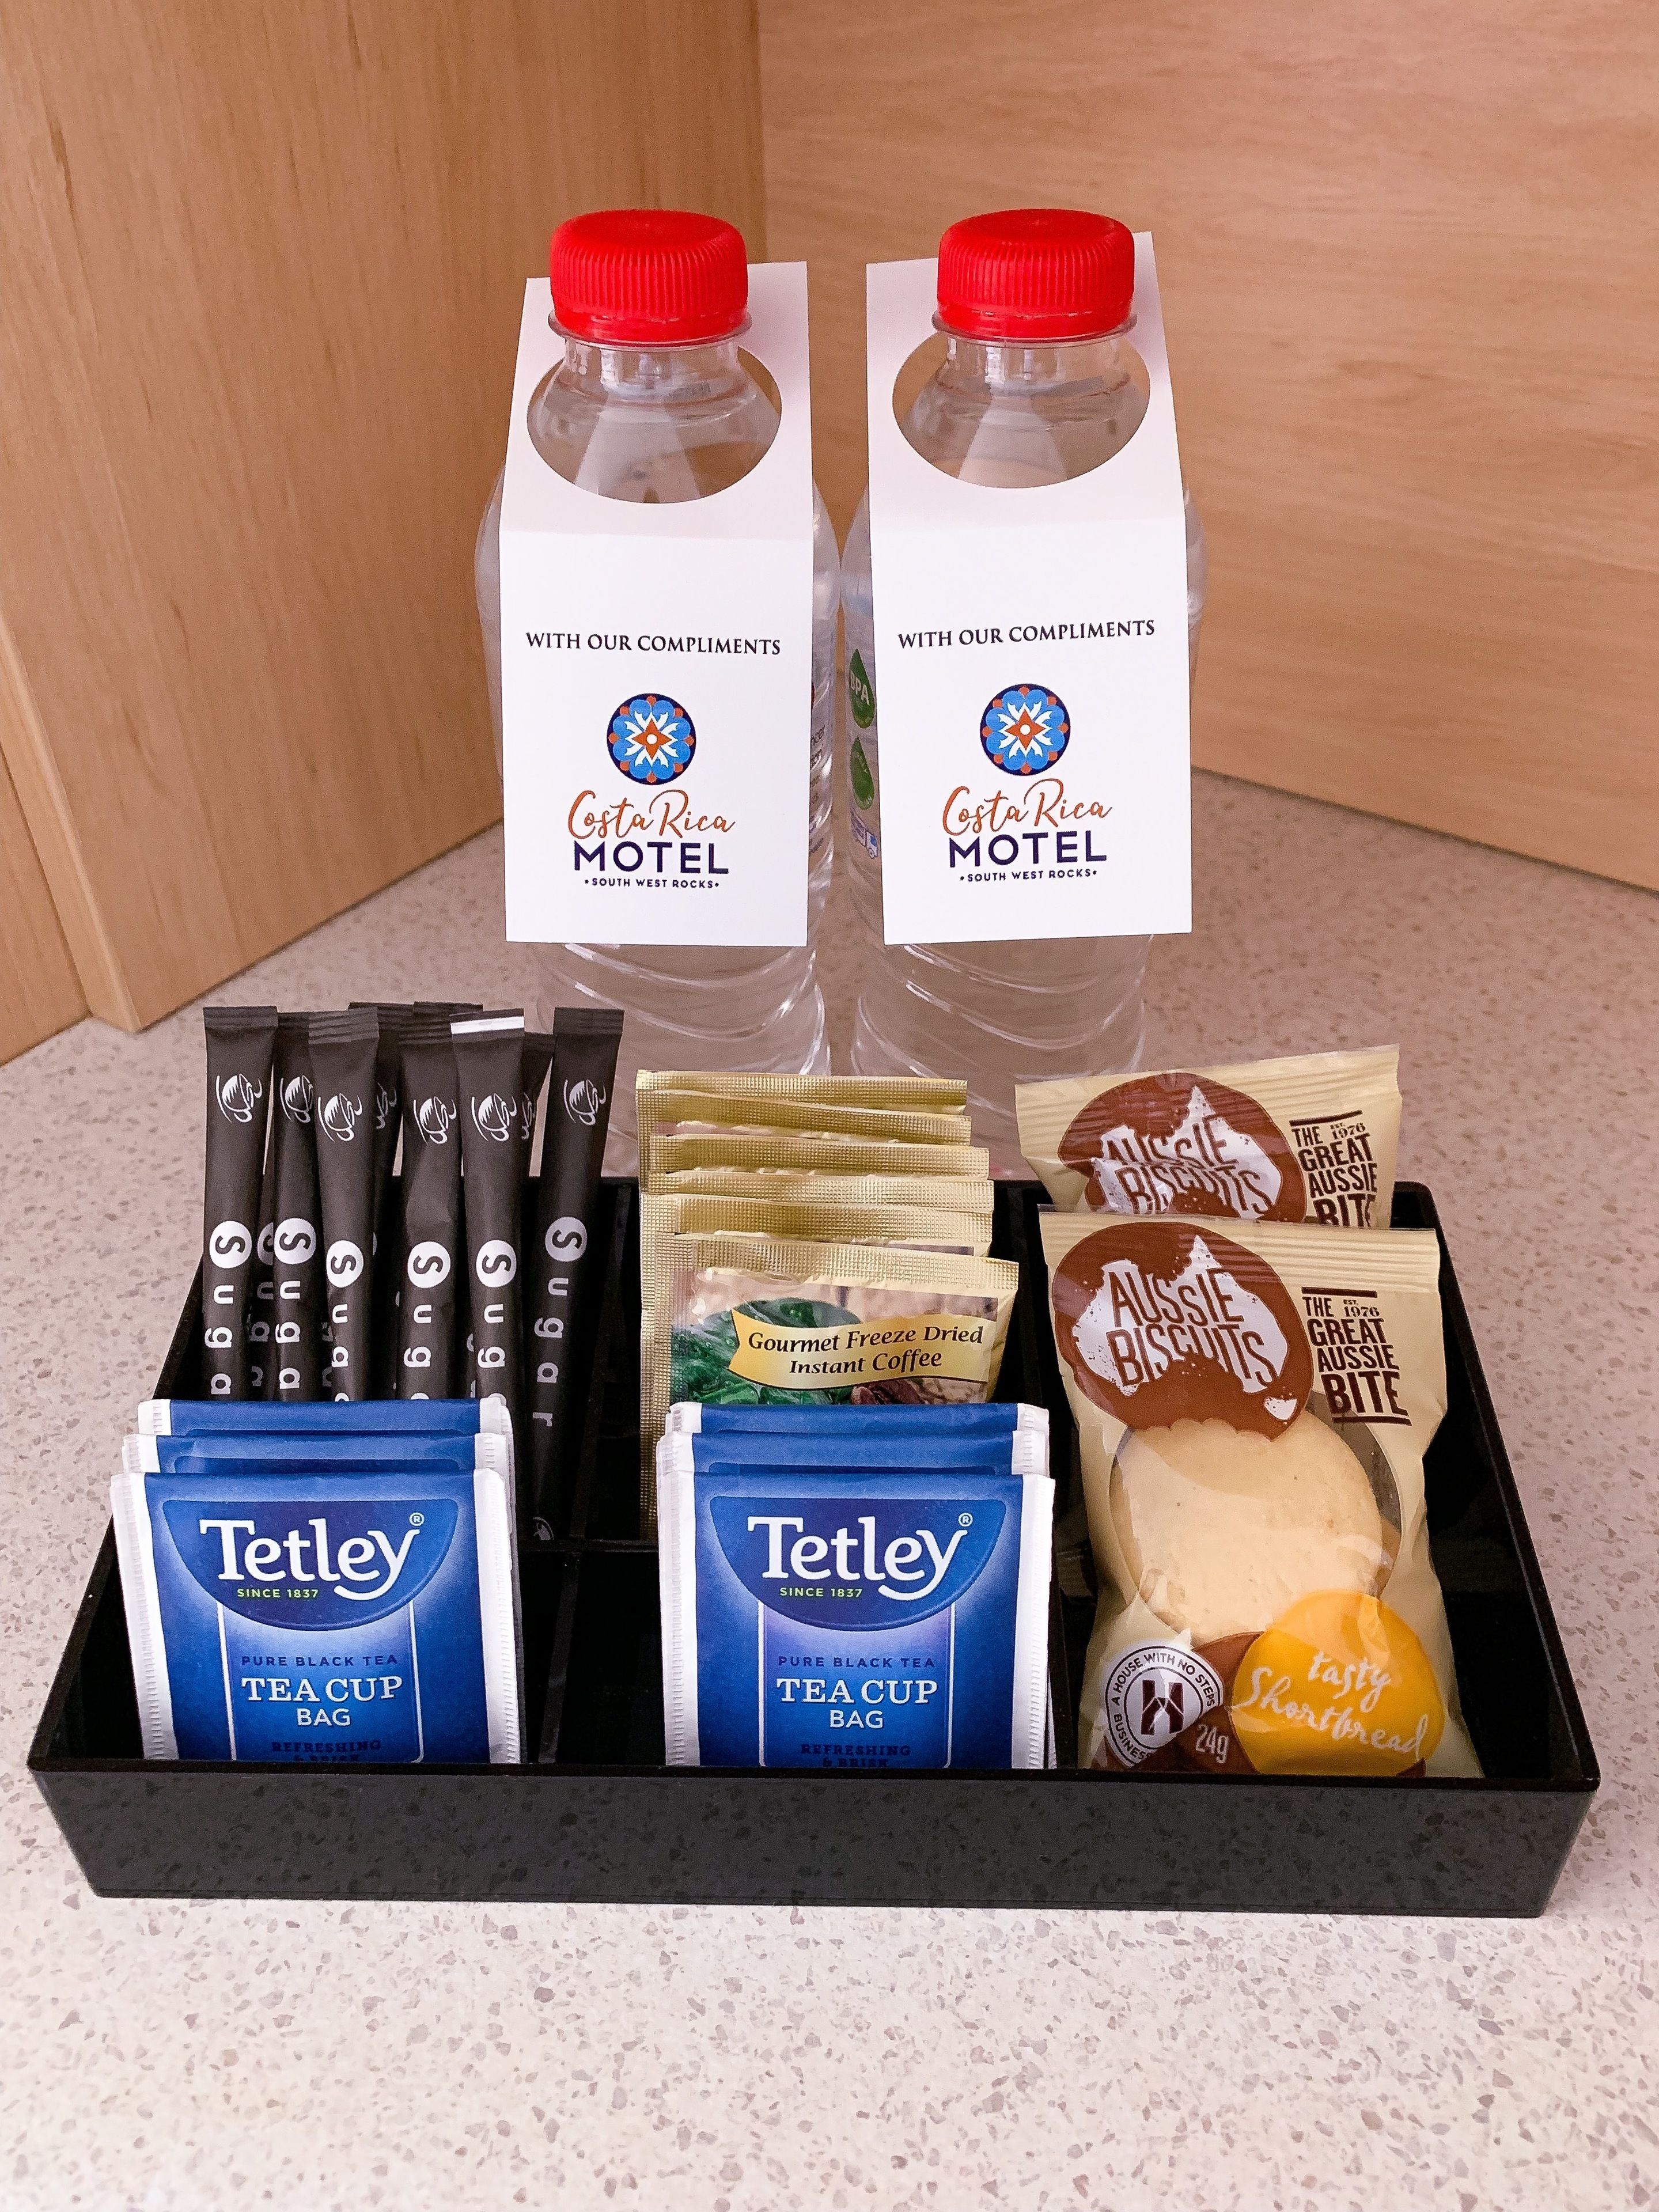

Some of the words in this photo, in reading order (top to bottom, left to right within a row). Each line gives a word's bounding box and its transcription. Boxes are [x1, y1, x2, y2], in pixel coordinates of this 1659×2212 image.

[526, 632, 580, 650] WITH
[588, 634, 632, 652] OUR
[638, 635, 781, 656] COMPLIMENTS
[898, 631, 952, 649] WITH
[959, 628, 1004, 645] OUR
[1009, 619, 1156, 643] COMPLIMENTS
[568, 790, 653, 840] Costa
[649, 789, 736, 839] Rica
[942, 785, 1029, 836] Costa
[1023, 778, 1113, 828] Rica
[574, 840, 729, 874] MOTEL
[949, 830, 1107, 868] MOTEL
[592, 877, 631, 888] SOUTH
[636, 878, 668, 888] WEST
[672, 879, 714, 889] ROCKS
[967, 872, 1006, 882] SOUTH
[1011, 870, 1044, 880] WEST
[1048, 868, 1091, 878] ROCKS
[1107, 1114, 1239, 1170] AUSSIE
[1291, 1126, 1324, 1147] THE
[1332, 1123, 1366, 1140] 1976
[1297, 1132, 1373, 1172] GREAT
[1114, 1164, 1277, 1215] BISCUITS
[1308, 1162, 1378, 1199] AUSSIE
[275, 1232, 312, 1389] Suga
[1111, 1267, 1244, 1328] AUSSIE
[1302, 1296, 1335, 1317] THE
[1343, 1306, 1380, 1317] 1976
[204, 1234, 248, 1395] Suga
[532, 1229, 583, 1427] Sugar
[748, 1331, 839, 1354] Gourmet
[846, 1329, 917, 1350] Freeze
[922, 1324, 984, 1345] Dried
[1306, 1317, 1388, 1347] GREAT
[789, 1357, 865, 1375] Instant
[872, 1349, 943, 1374] Coffee
[1105, 1322, 1281, 1388] BISCUITS
[1317, 1344, 1400, 1373] AUSSIE
[1320, 1370, 1410, 1418] BITE
[199, 1518, 421, 1601] Tetley
[747, 1516, 968, 1601] Tetley
[237, 1589, 281, 1600] SINCE
[286, 1588, 319, 1600] 1837
[779, 1587, 824, 1599] SINCE
[830, 1588, 863, 1599] 1837
[241, 1656, 287, 1666] PURE
[295, 1656, 354, 1667] BLACK
[361, 1654, 399, 1665] TEA
[778, 1656, 825, 1668] PURE
[833, 1657, 895, 1668] BLACK
[900, 1657, 935, 1668] TEA
[1143, 1652, 1176, 1665] WITH
[1177, 1658, 1196, 1676] NO
[241, 1677, 320, 1703] TEA
[324, 1675, 403, 1703] CUP
[1112, 1657, 1143, 1694] HOUSE
[1195, 1673, 1215, 1707] STEPS
[1308, 1650, 1392, 1713] tasty
[777, 1677, 855, 1704] TEA
[861, 1679, 938, 1705] CUP
[1111, 1696, 1121, 1706] A
[297, 1707, 351, 1728] BAG
[829, 1710, 884, 1729] BAG
[1235, 1667, 1429, 1762] Shortbread
[271, 1740, 381, 1753] REFRESHING
[801, 1744, 911, 1756] REFRESHING
[1195, 1724, 1229, 1764] 24g
